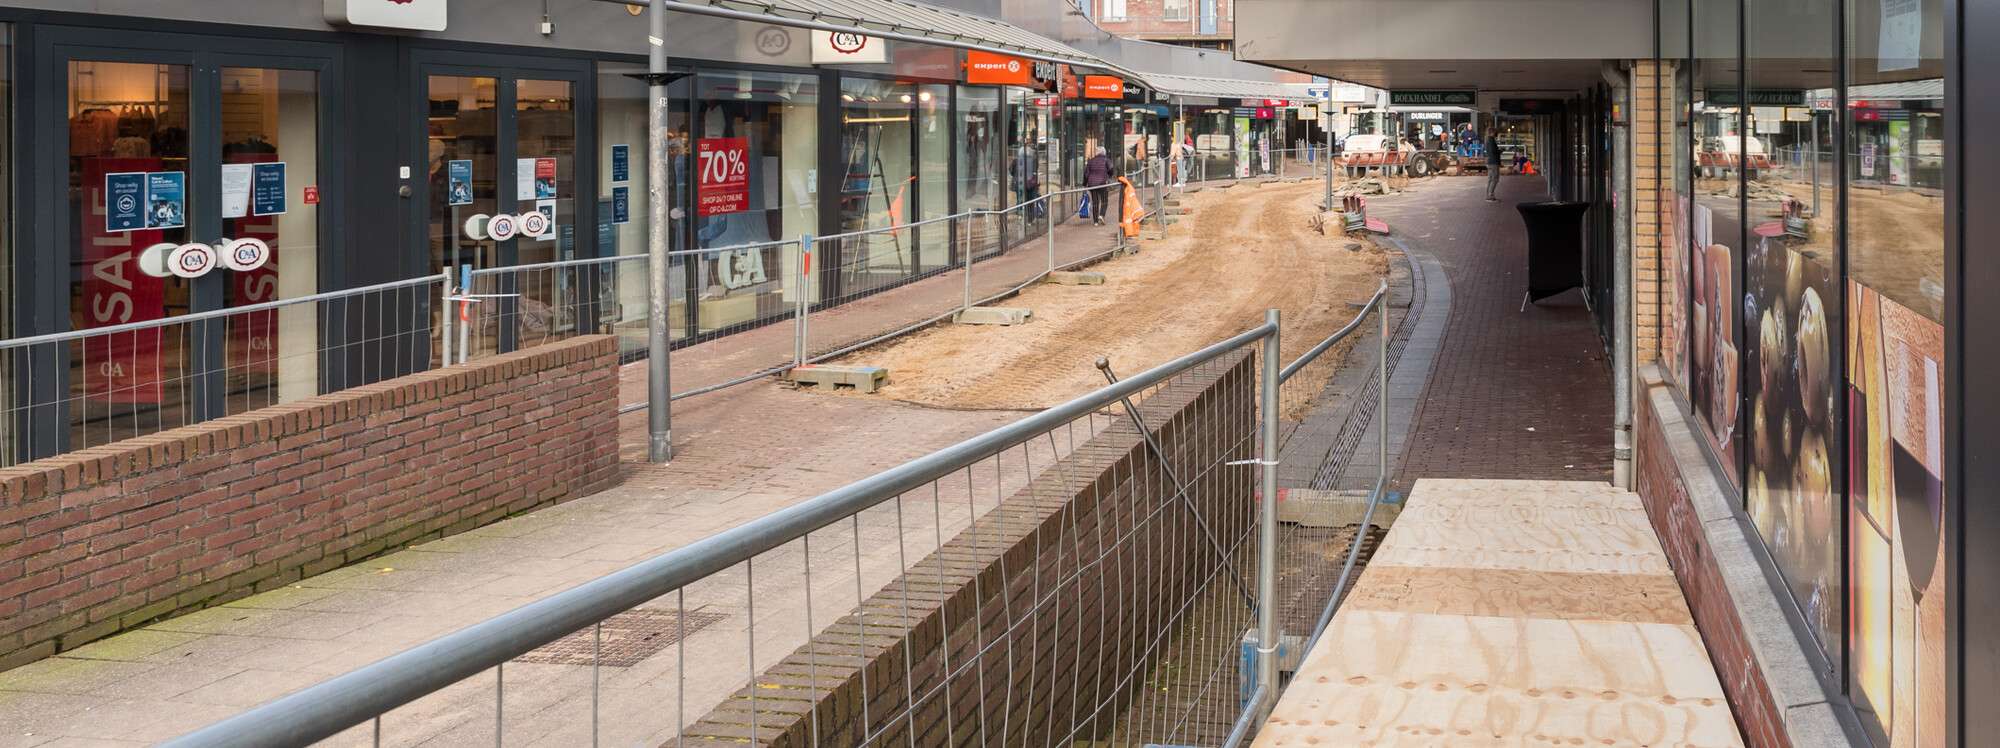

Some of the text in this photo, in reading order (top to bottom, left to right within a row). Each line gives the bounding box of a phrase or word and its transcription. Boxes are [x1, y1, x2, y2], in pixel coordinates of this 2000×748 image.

[836, 32, 860, 46] C&A
[1035, 62, 1056, 83] expert
[1123, 86, 1141, 95] hoeby
[1394, 94, 1443, 103] BOEKHANDEL
[1411, 112, 1443, 120] DURLINGER
[700, 149, 745, 184] 70%
[702, 194, 743, 205] SHOP 24/7 ONLINE
[497, 223, 509, 232] C&A
[529, 220, 541, 228] C&A
[238, 248, 257, 260] C&A
[184, 254, 204, 266] C&A
[718, 241, 767, 289] C&A
